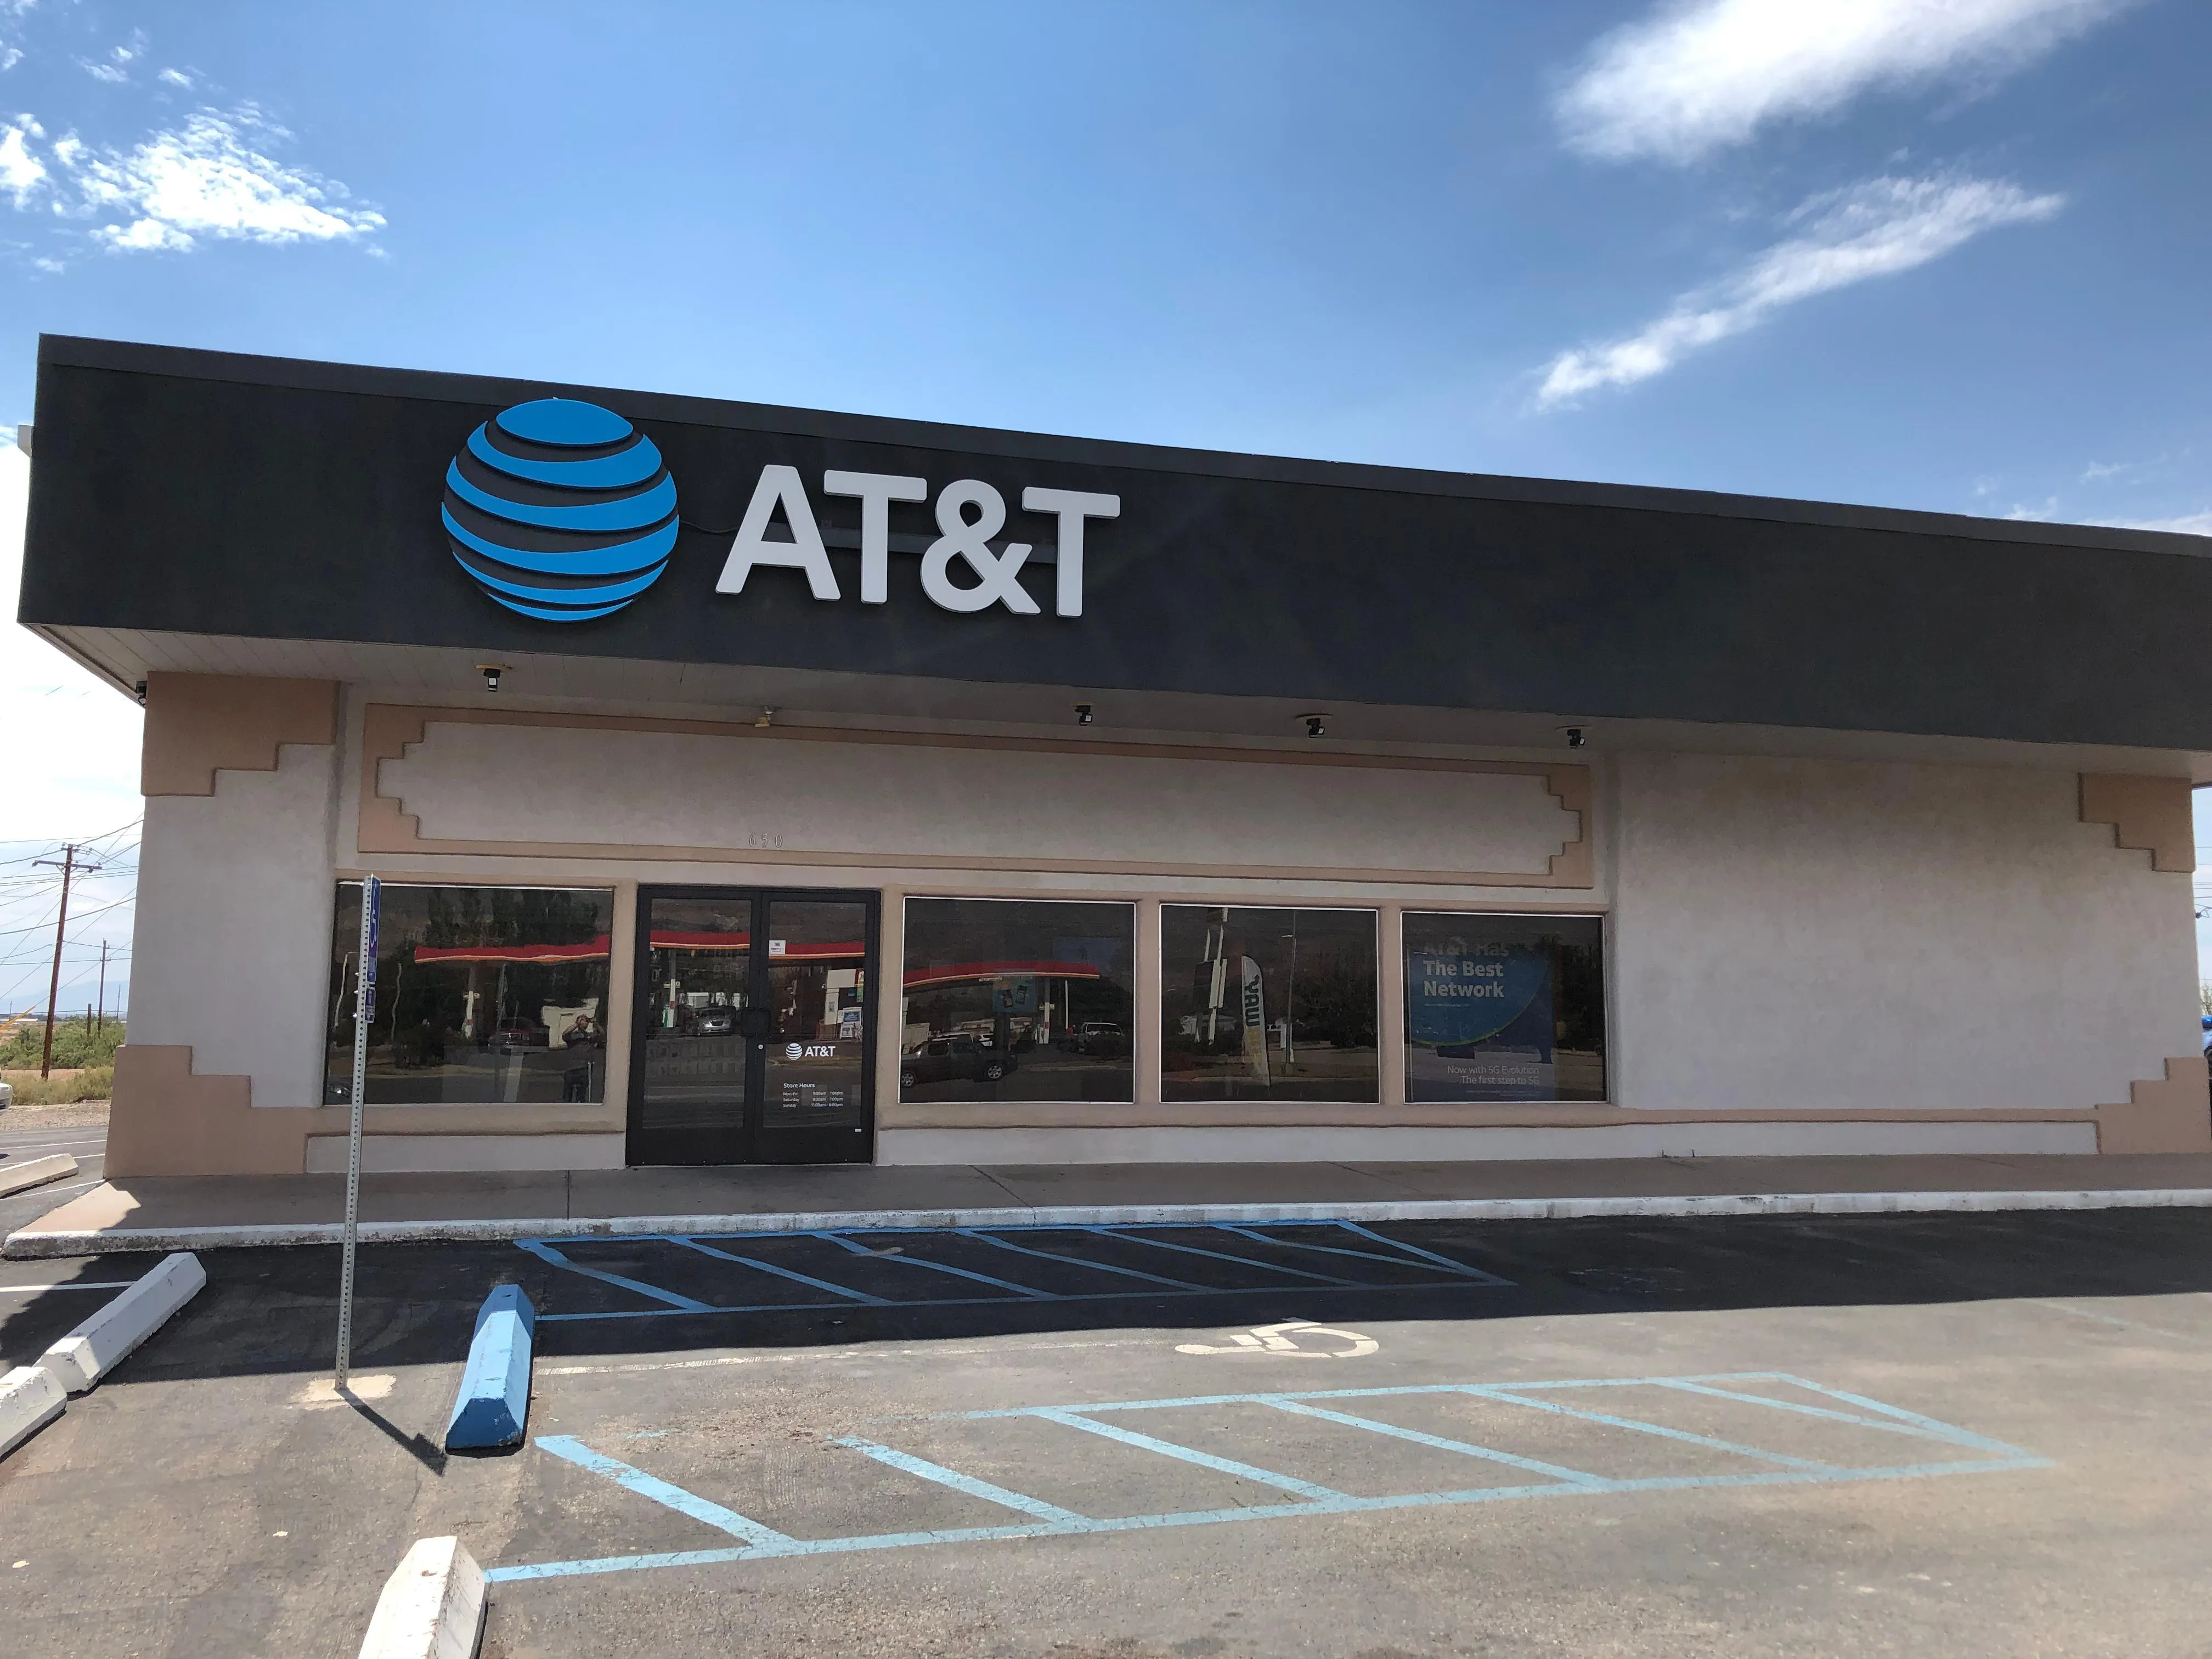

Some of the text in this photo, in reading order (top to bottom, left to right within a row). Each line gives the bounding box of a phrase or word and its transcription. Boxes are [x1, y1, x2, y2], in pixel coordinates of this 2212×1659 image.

[715, 464, 1120, 618] AT&T
[749, 833, 783, 848] 650
[1423, 960, 1504, 977] The Best
[1424, 980, 1505, 997] Network
[804, 1046, 836, 1057] AT&T
[1448, 1065, 1466, 1074] Now
[1468, 1065, 1487, 1074] with
[1502, 1066, 1539, 1074] Evolution
[1460, 1075, 1540, 1086] The first step to 5G
